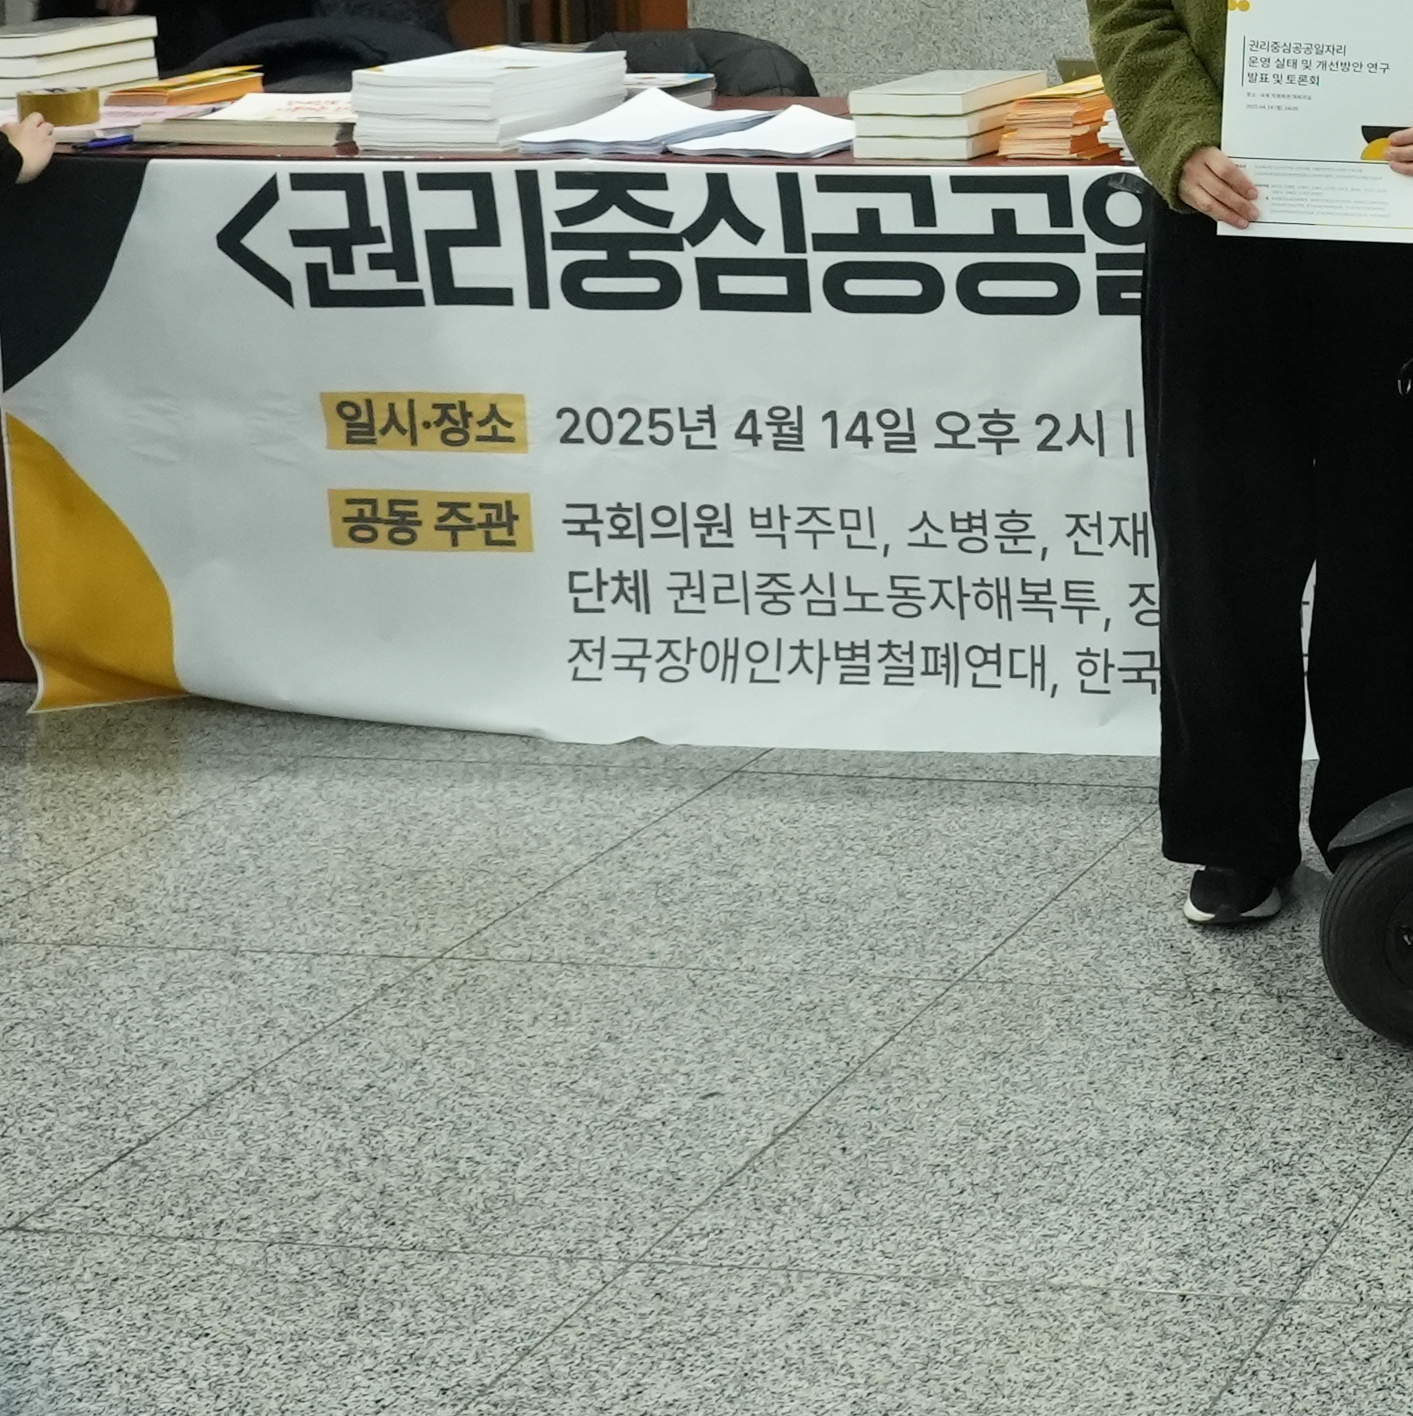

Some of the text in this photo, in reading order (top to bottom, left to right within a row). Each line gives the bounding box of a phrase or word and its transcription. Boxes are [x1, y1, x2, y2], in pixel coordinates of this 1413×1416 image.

[215, 169, 1147, 316] <권리중심공공
[336, 398, 516, 447] 일시·장소
[556, 405, 1104, 457] 2025년 4월 14일 오후 2시
[342, 498, 518, 547] 공동 주관
[562, 502, 1150, 561] 국회의원 박주민, 소병훈, 전재
[569, 568, 650, 614] 단체
[667, 570, 1110, 632] 권리중심노동자해복투,
[568, 636, 1057, 698] 전국장애인차별철폐연대,
